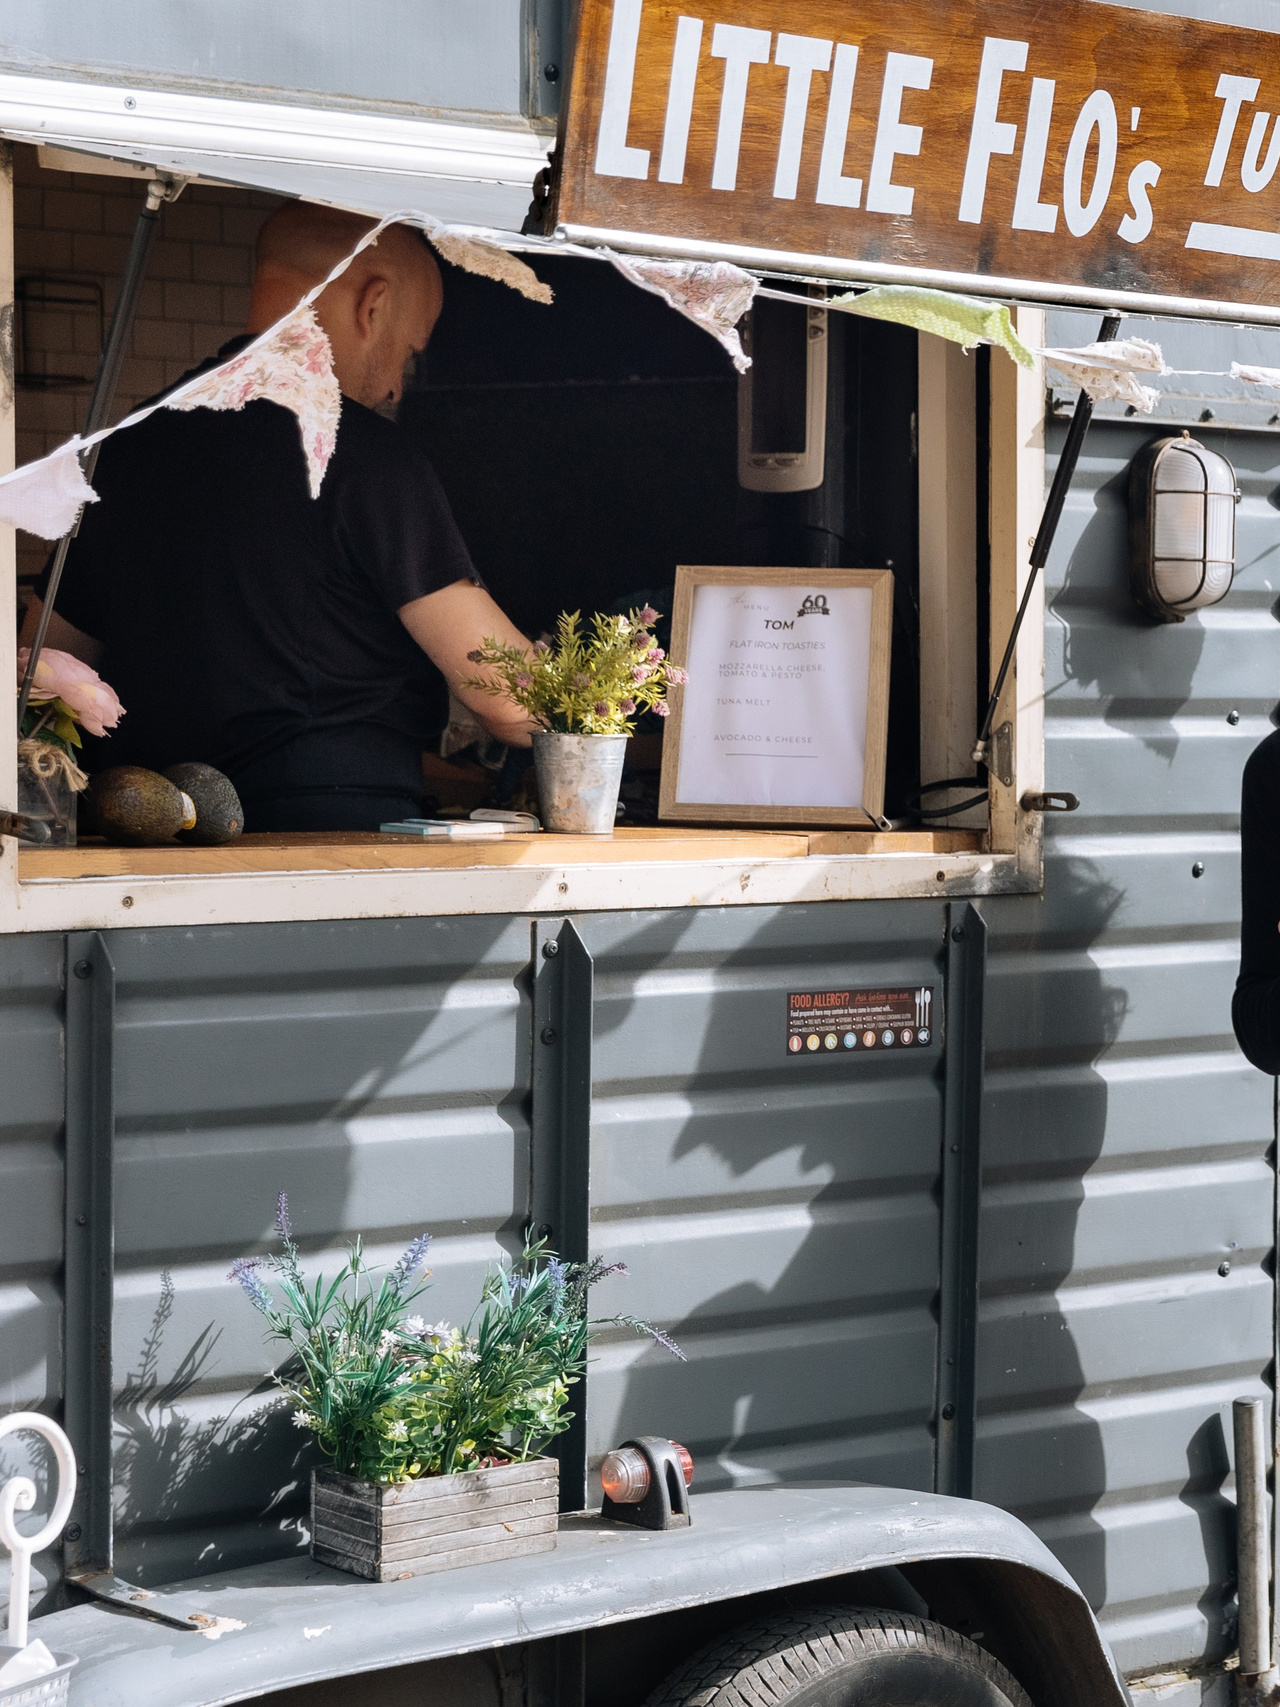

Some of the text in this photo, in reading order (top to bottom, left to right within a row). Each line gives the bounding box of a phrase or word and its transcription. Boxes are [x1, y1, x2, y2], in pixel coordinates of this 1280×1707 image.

[594, 0, 933, 216] LITTLE
[801, 594, 828, 610] 60
[764, 620, 795, 630] TOM
[729, 640, 826, 650] FLAT IRON TOASTIES
[719, 662, 782, 672] MOZZARELLA
[719, 670, 758, 678] TOMATO
[771, 672, 802, 680] PESTO
[714, 734, 762, 742] AVOCADO
[774, 736, 813, 744] CHEESE
[790, 992, 850, 1008] FOOD ALLERGY?
